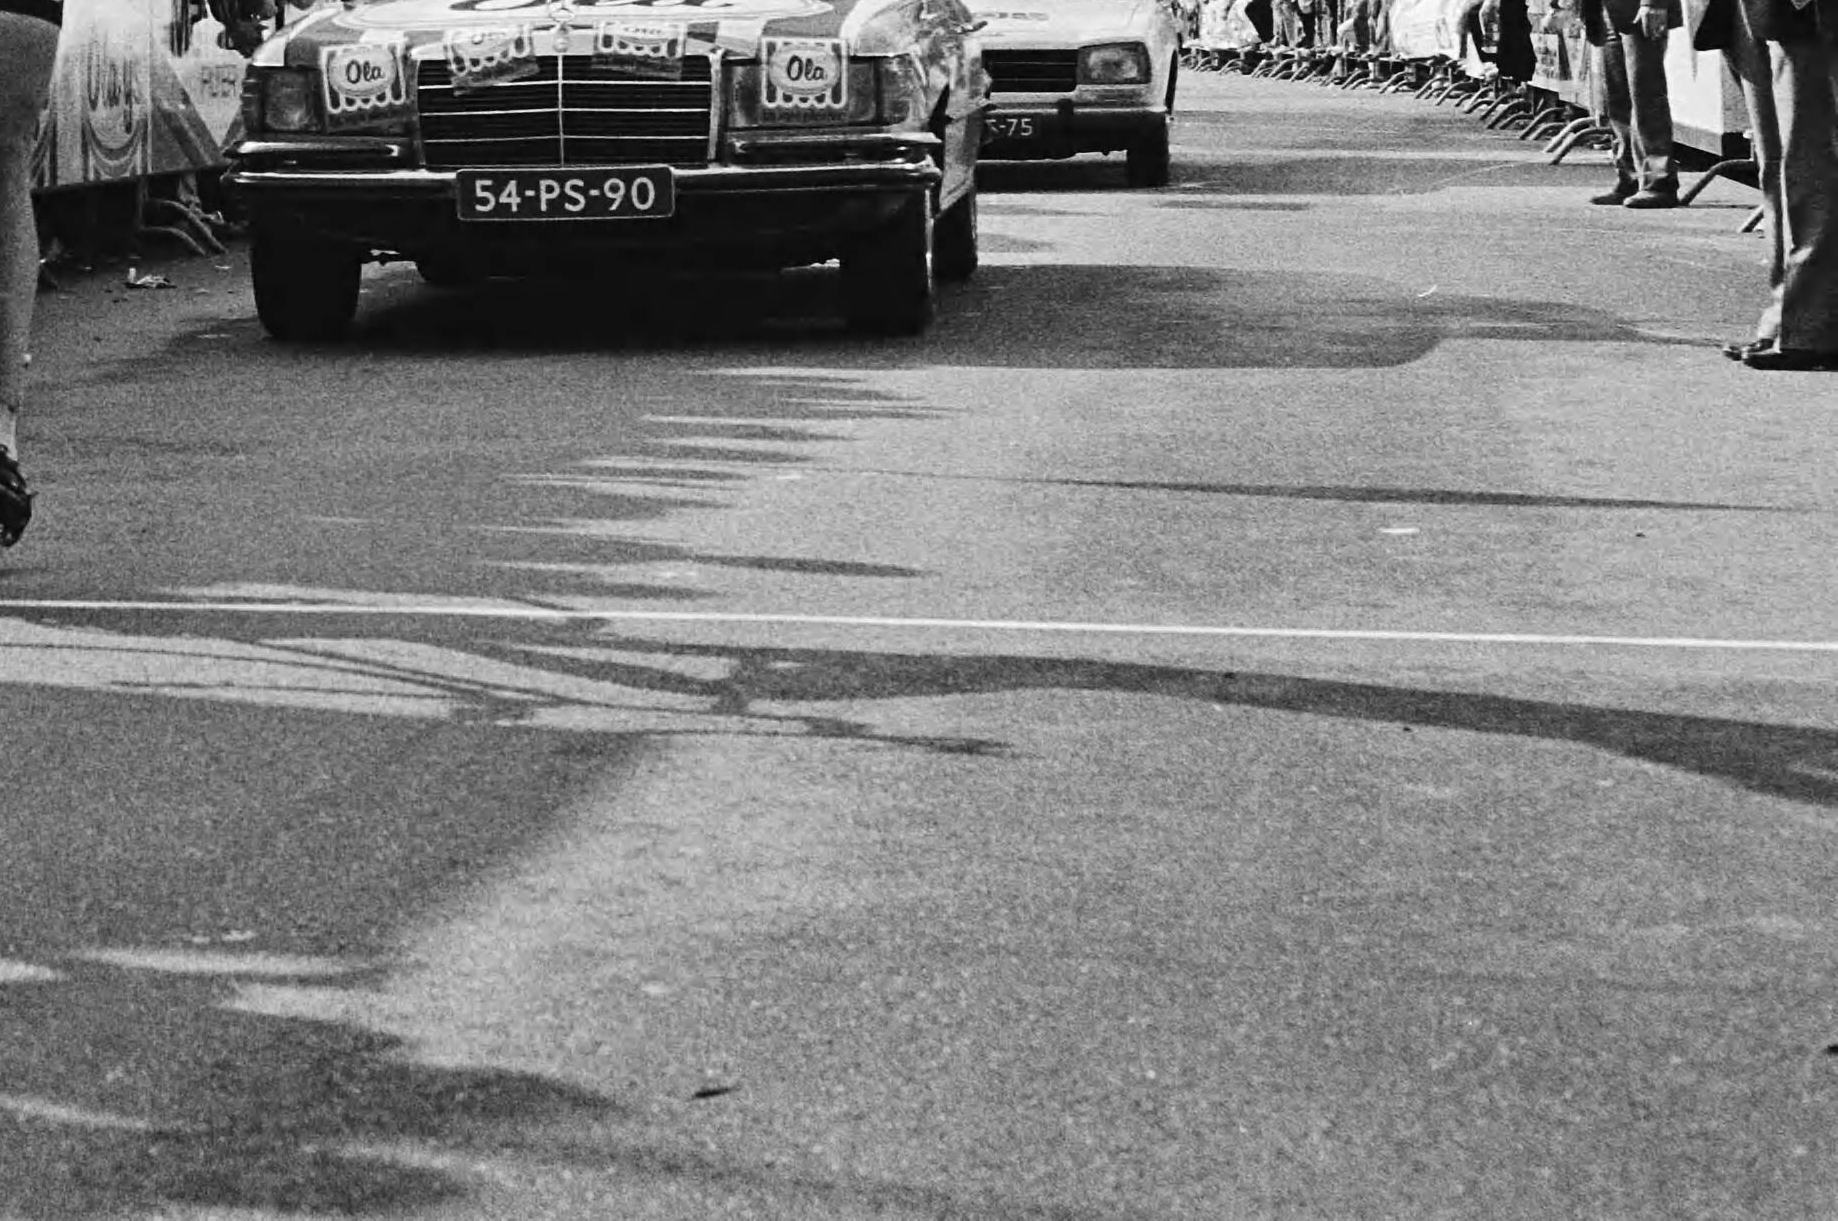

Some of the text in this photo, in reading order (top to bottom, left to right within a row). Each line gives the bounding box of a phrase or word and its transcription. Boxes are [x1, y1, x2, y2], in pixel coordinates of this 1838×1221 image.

[346, 59, 384, 85] Ola
[786, 54, 826, 83] Ola
[475, 176, 656, 212] 54-PS-90
